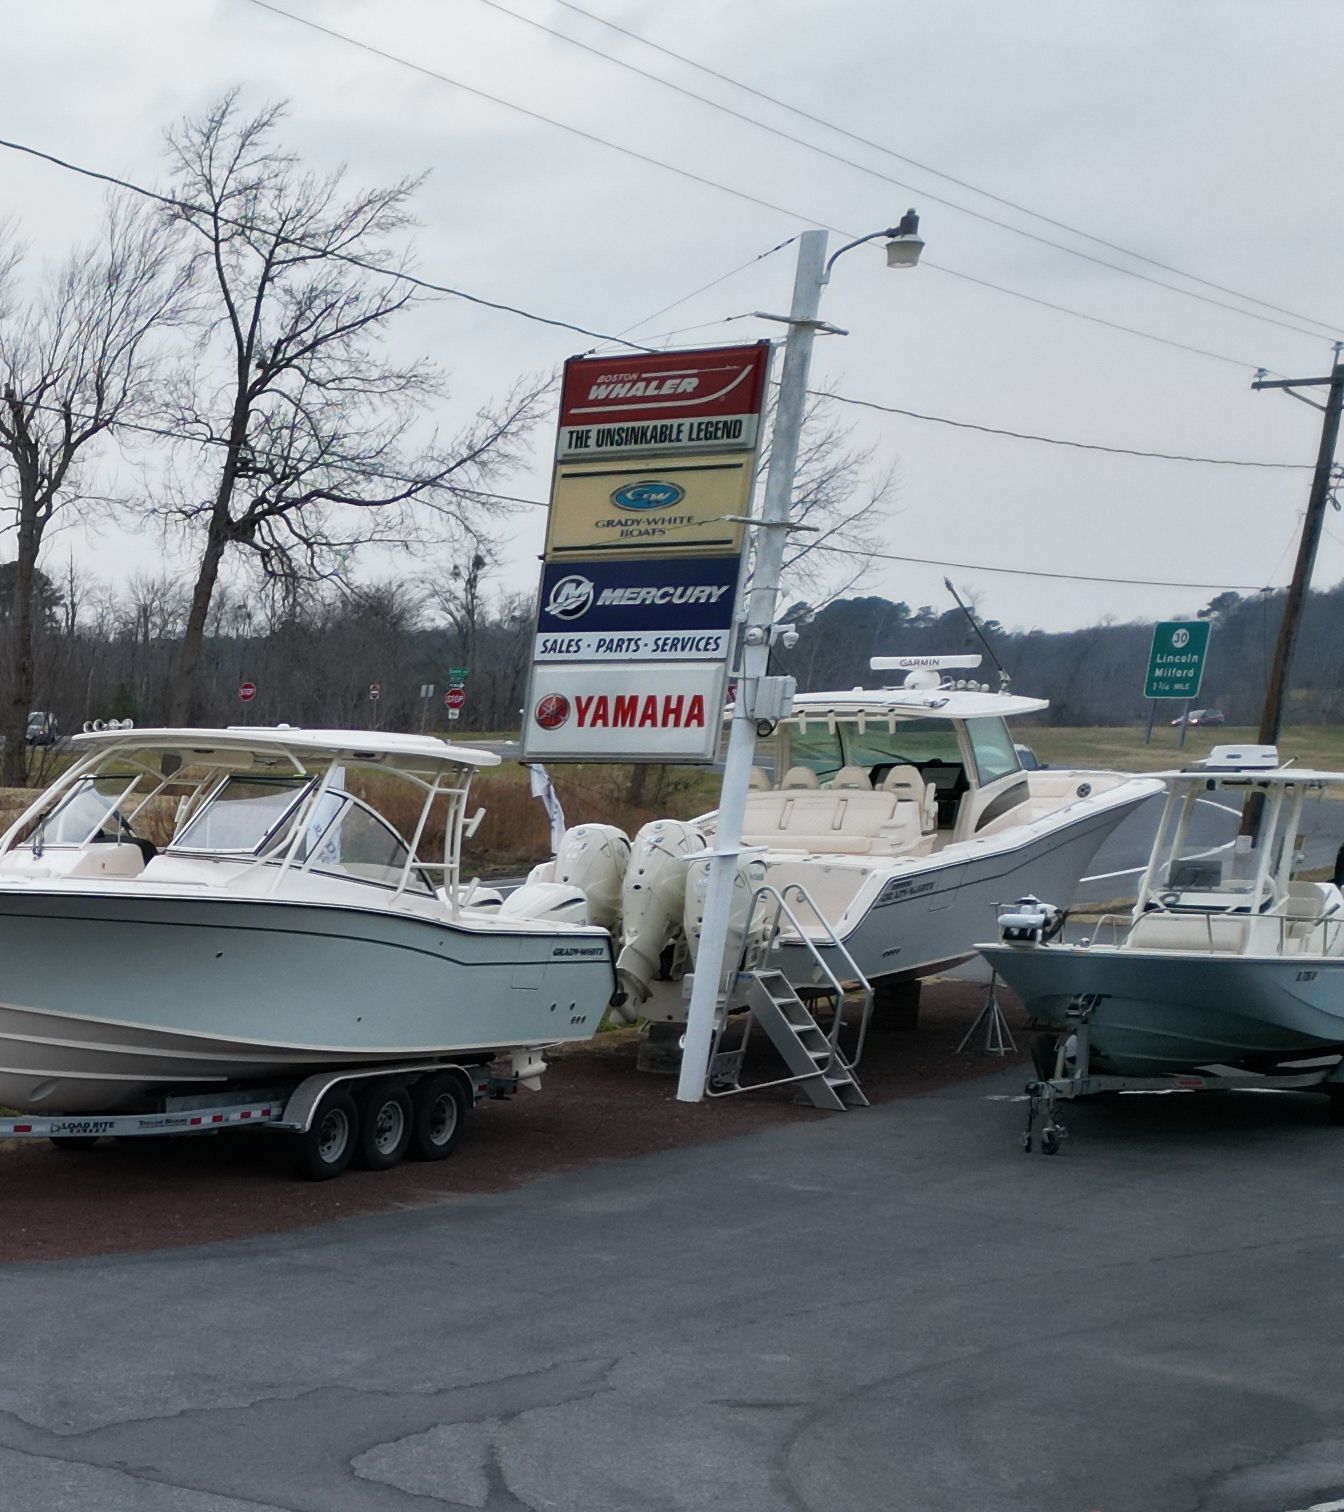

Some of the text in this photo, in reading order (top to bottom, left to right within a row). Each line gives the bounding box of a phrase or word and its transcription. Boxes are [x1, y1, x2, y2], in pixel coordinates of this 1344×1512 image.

[597, 372, 640, 383] BOSTON
[588, 378, 699, 400] WHALER
[568, 419, 743, 449] THE UNSINKABLE LEGEND
[595, 516, 694, 528] GRADY-WHITE
[620, 528, 666, 538] BOATS
[596, 585, 730, 606] MERCURY
[1173, 632, 1188, 644] 30
[540, 636, 722, 654] SALES PARTS SERVICES
[899, 659, 940, 667] GARMIN
[1156, 653, 1199, 663] Lincoln
[1154, 668, 1194, 678] Milford
[575, 694, 705, 729] YAMAHA
[62, 1121, 114, 1130] LOAD RITE
